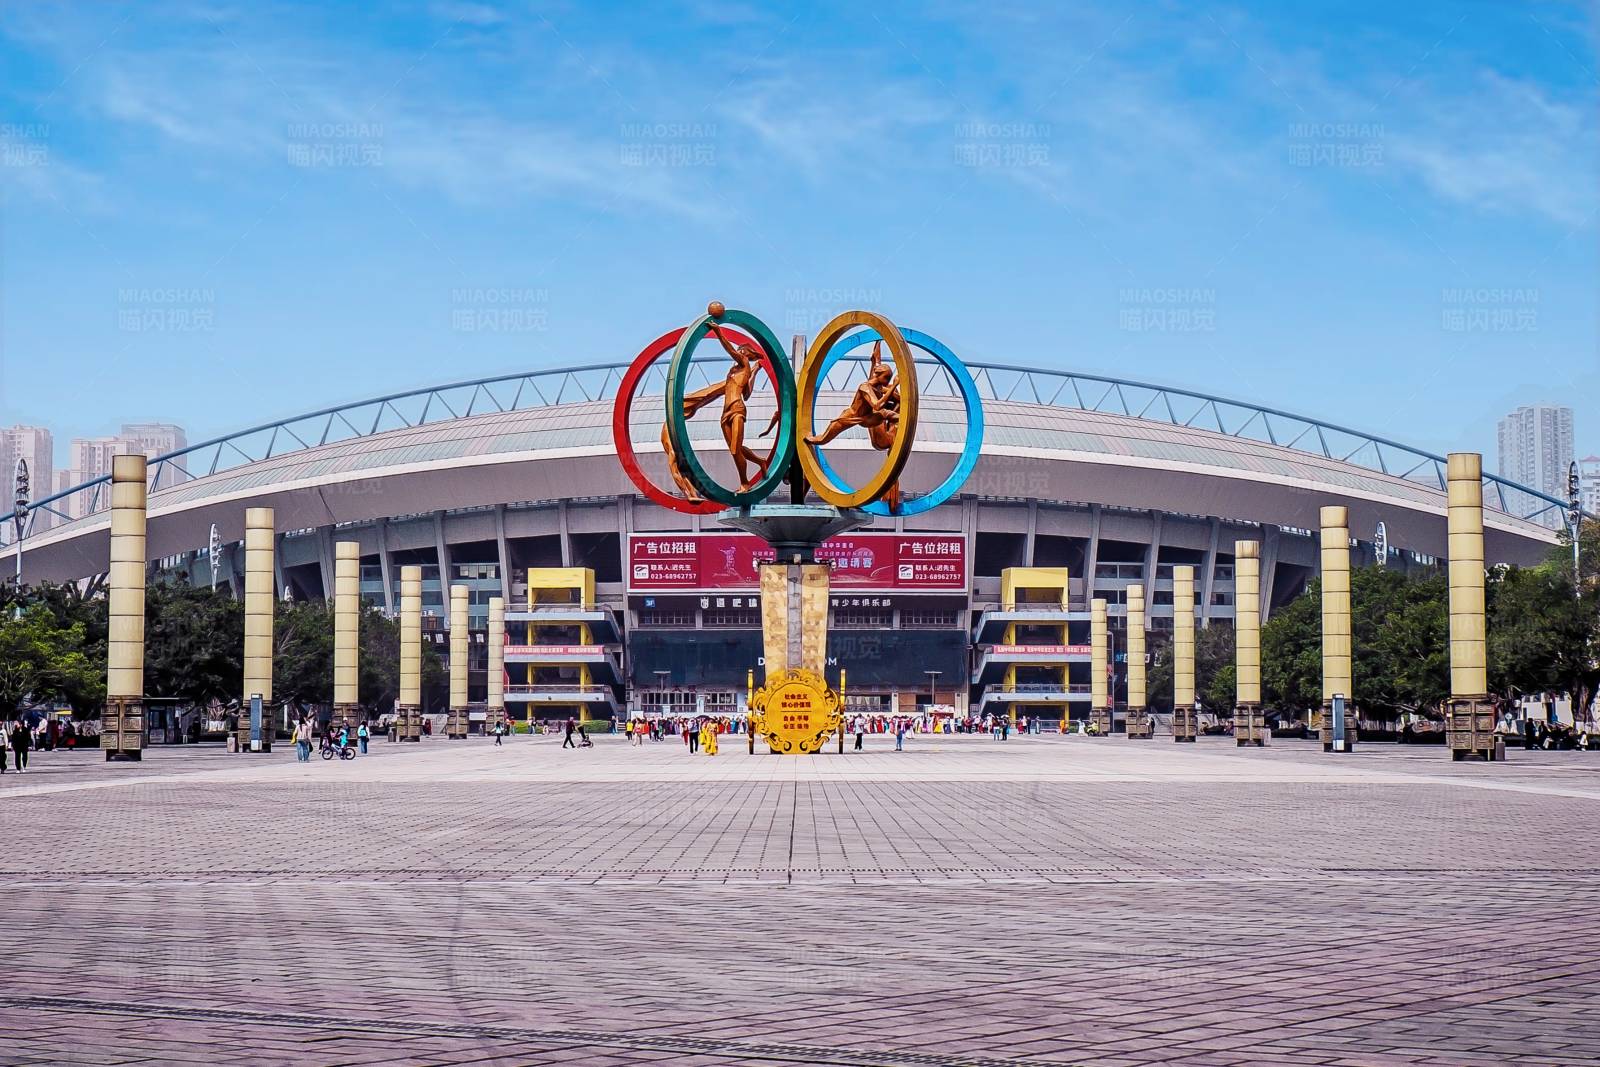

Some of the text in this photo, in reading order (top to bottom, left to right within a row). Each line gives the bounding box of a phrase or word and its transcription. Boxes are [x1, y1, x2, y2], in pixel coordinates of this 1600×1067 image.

[633, 541, 697, 555] 广告位招租
[898, 541, 961, 555] 广告位招租
